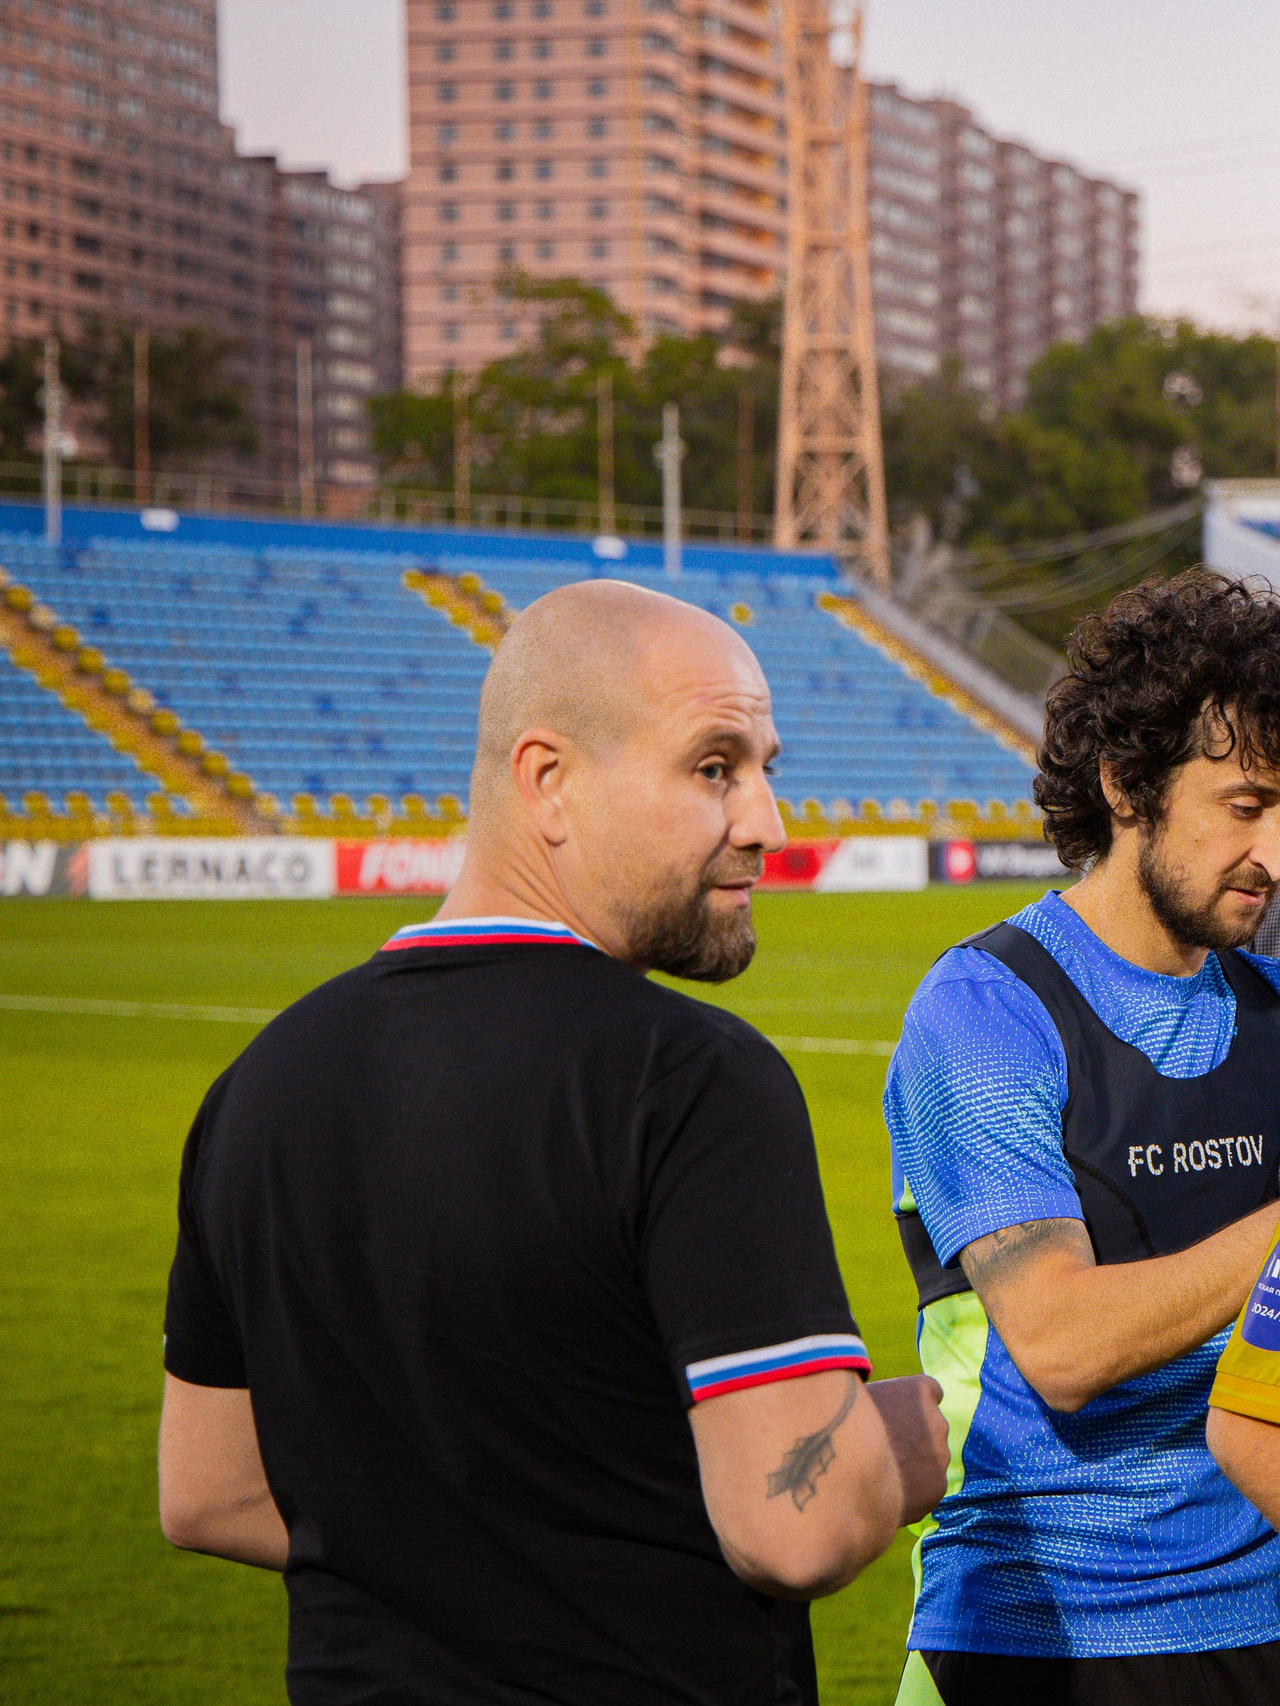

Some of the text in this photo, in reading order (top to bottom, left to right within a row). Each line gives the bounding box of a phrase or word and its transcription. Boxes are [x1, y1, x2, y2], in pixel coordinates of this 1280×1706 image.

[113, 855, 315, 887] LERNACO
[1128, 1135, 1263, 1177] FC ROSTOV
